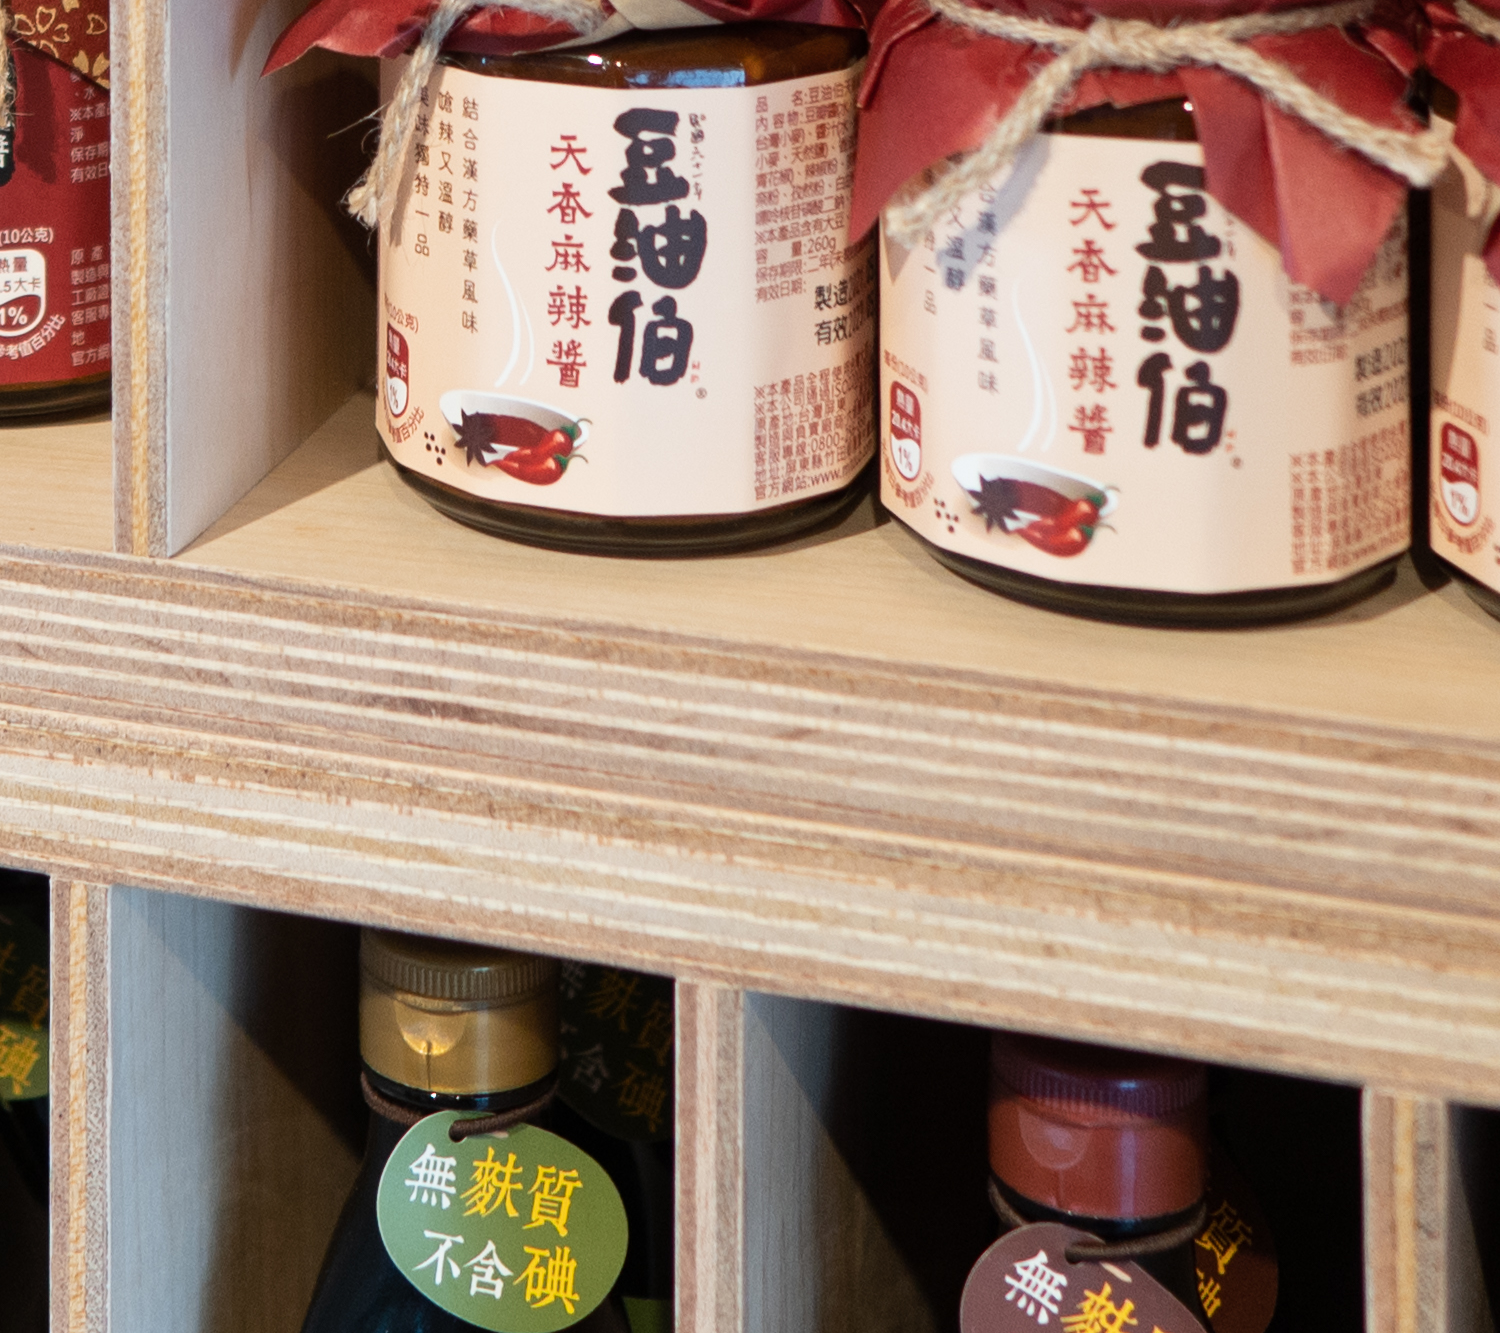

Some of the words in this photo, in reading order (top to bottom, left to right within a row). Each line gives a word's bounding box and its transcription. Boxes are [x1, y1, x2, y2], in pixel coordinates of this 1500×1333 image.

[461, 96, 479, 334] 結合漢方藥草風味
[545, 134, 593, 388] 天香麻辣醬
[607, 107, 708, 386] 豆油伯
[1066, 188, 1118, 456] 天香麻辣醬
[1134, 160, 1241, 456] 豆油伯
[897, 445, 914, 472] 1%
[404, 1143, 583, 1237] 無麩質
[411, 1229, 581, 1315] 不含碘
